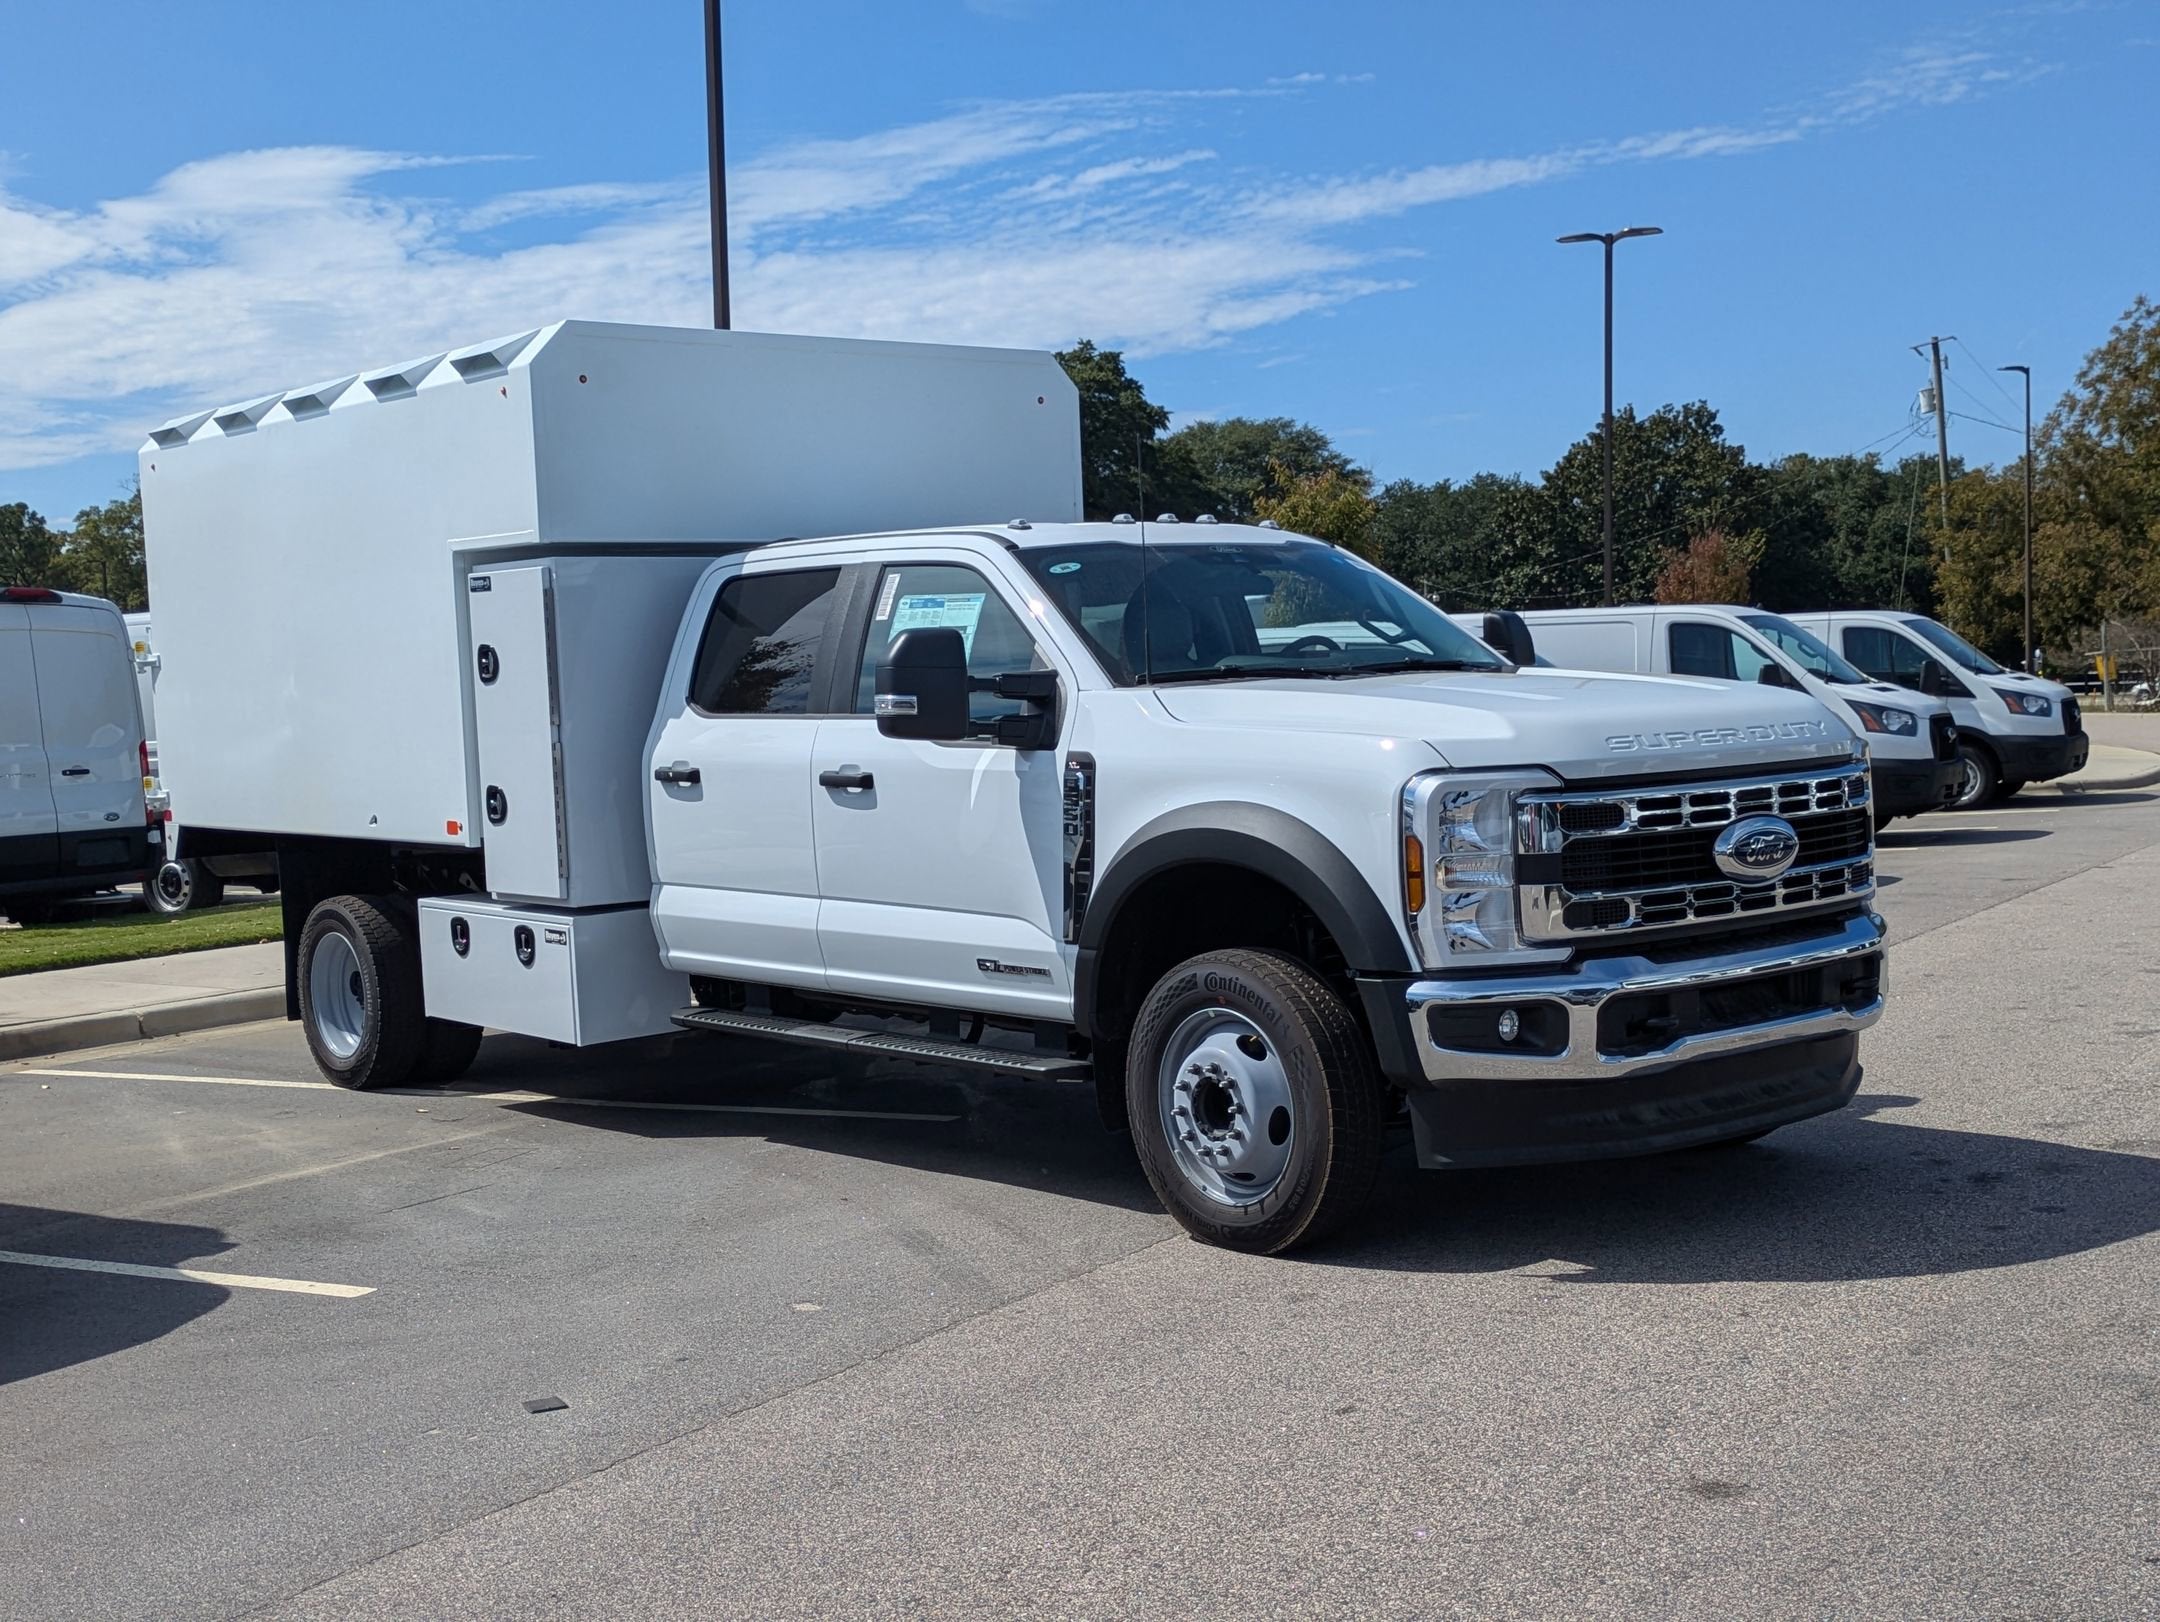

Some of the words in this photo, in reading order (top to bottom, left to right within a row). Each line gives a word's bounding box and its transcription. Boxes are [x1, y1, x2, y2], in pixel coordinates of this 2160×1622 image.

[1605, 728, 1747, 752] SUPER
[1746, 720, 1827, 741] DUTY
[1746, 834, 1787, 863] Ford
[1203, 971, 1284, 1025] Continental
